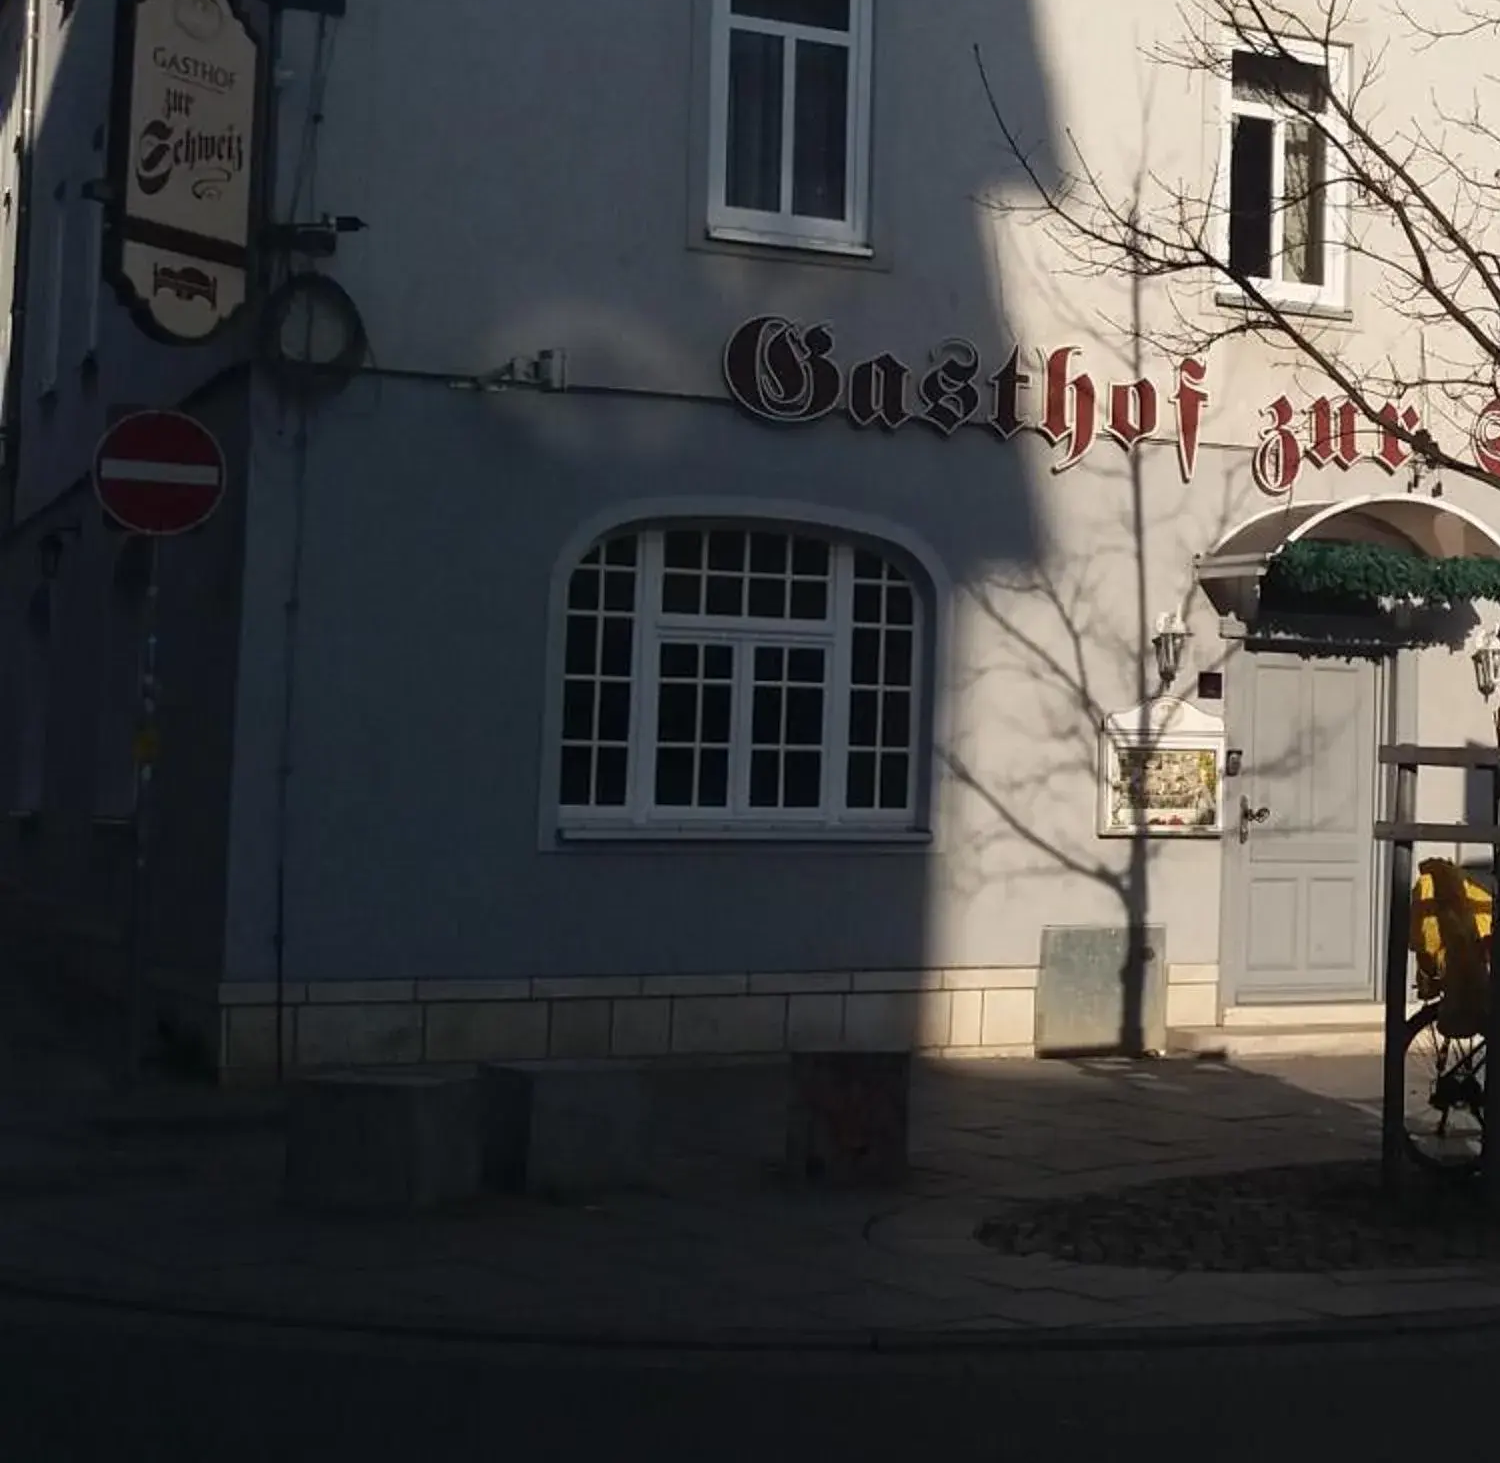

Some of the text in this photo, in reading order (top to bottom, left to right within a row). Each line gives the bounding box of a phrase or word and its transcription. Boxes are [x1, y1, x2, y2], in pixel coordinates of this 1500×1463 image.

[153, 48, 237, 89] GASTHOF
[164, 88, 195, 119] zur
[137, 121, 243, 195] Schweiz
[722, 314, 1209, 483] Gasthof
[1252, 395, 1422, 494] zur
